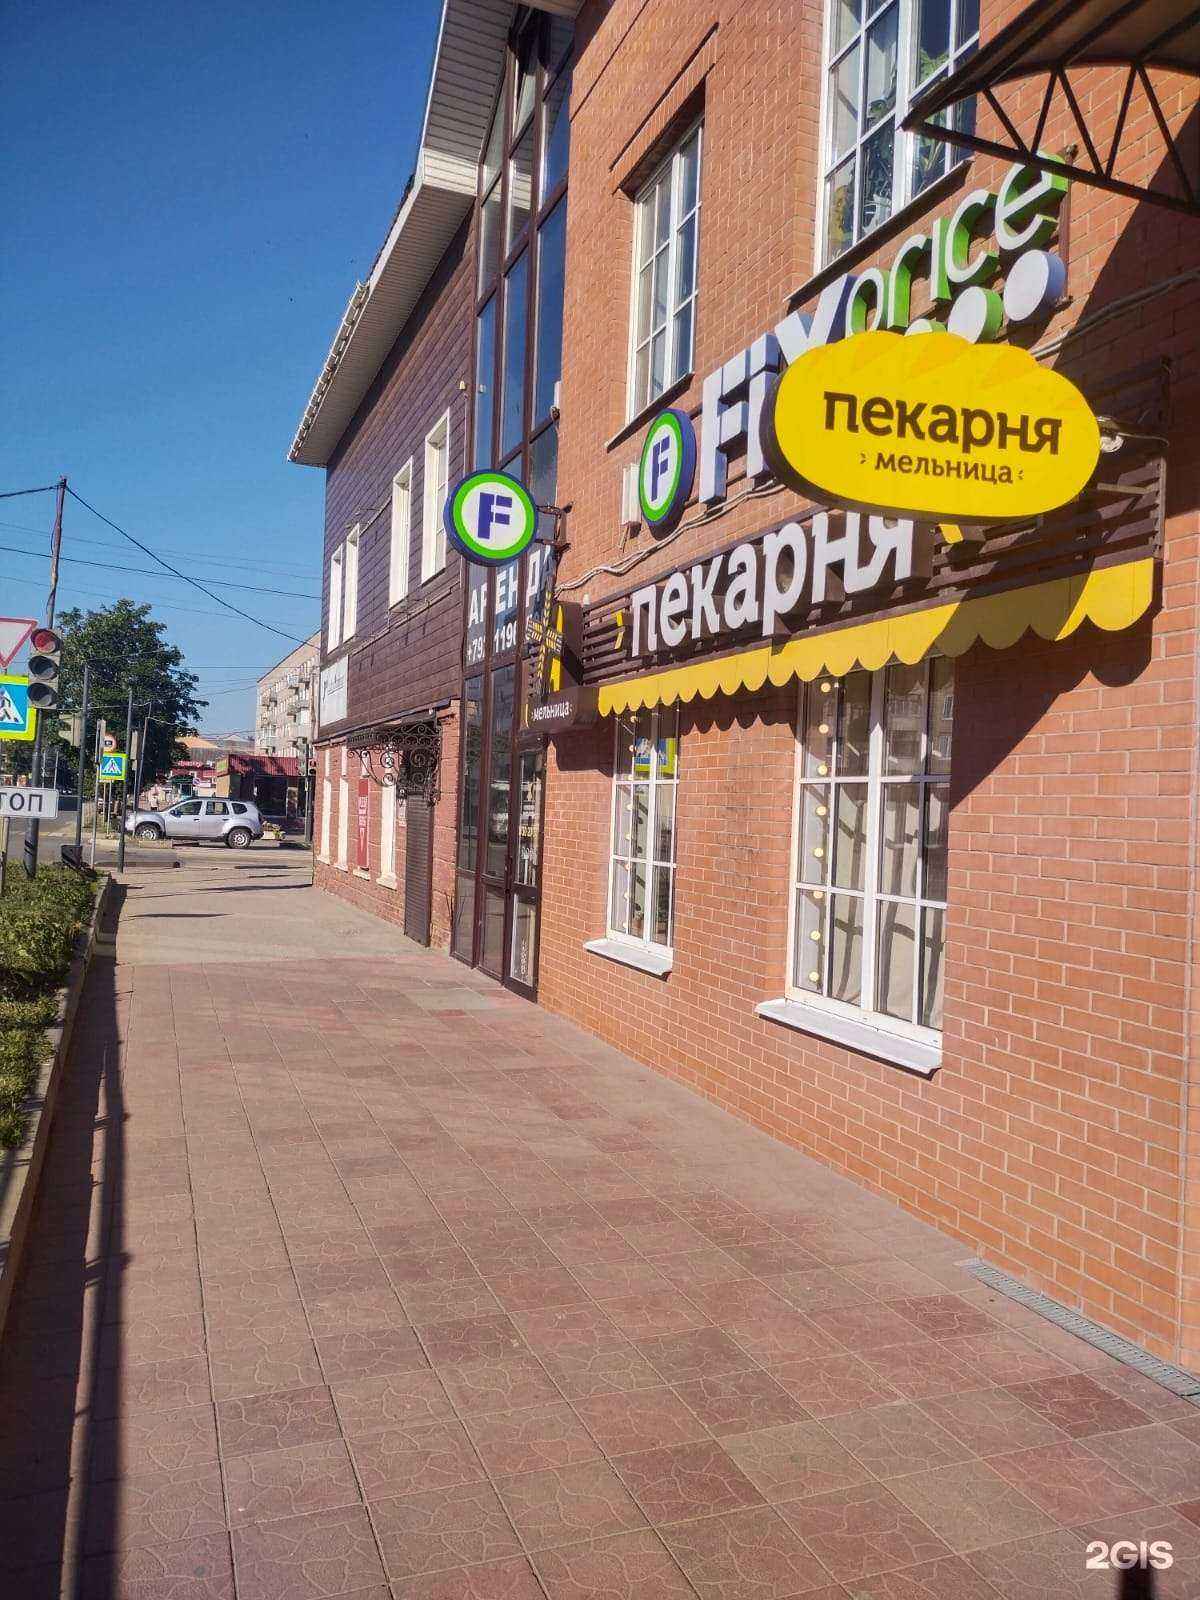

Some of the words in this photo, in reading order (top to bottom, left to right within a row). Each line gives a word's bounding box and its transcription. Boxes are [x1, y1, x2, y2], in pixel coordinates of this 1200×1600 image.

[823, 391, 1063, 455] пекарня
[875, 452, 1013, 484] мельница
[632, 512, 914, 657] пекарня
[533, 701, 570, 721] мельница
